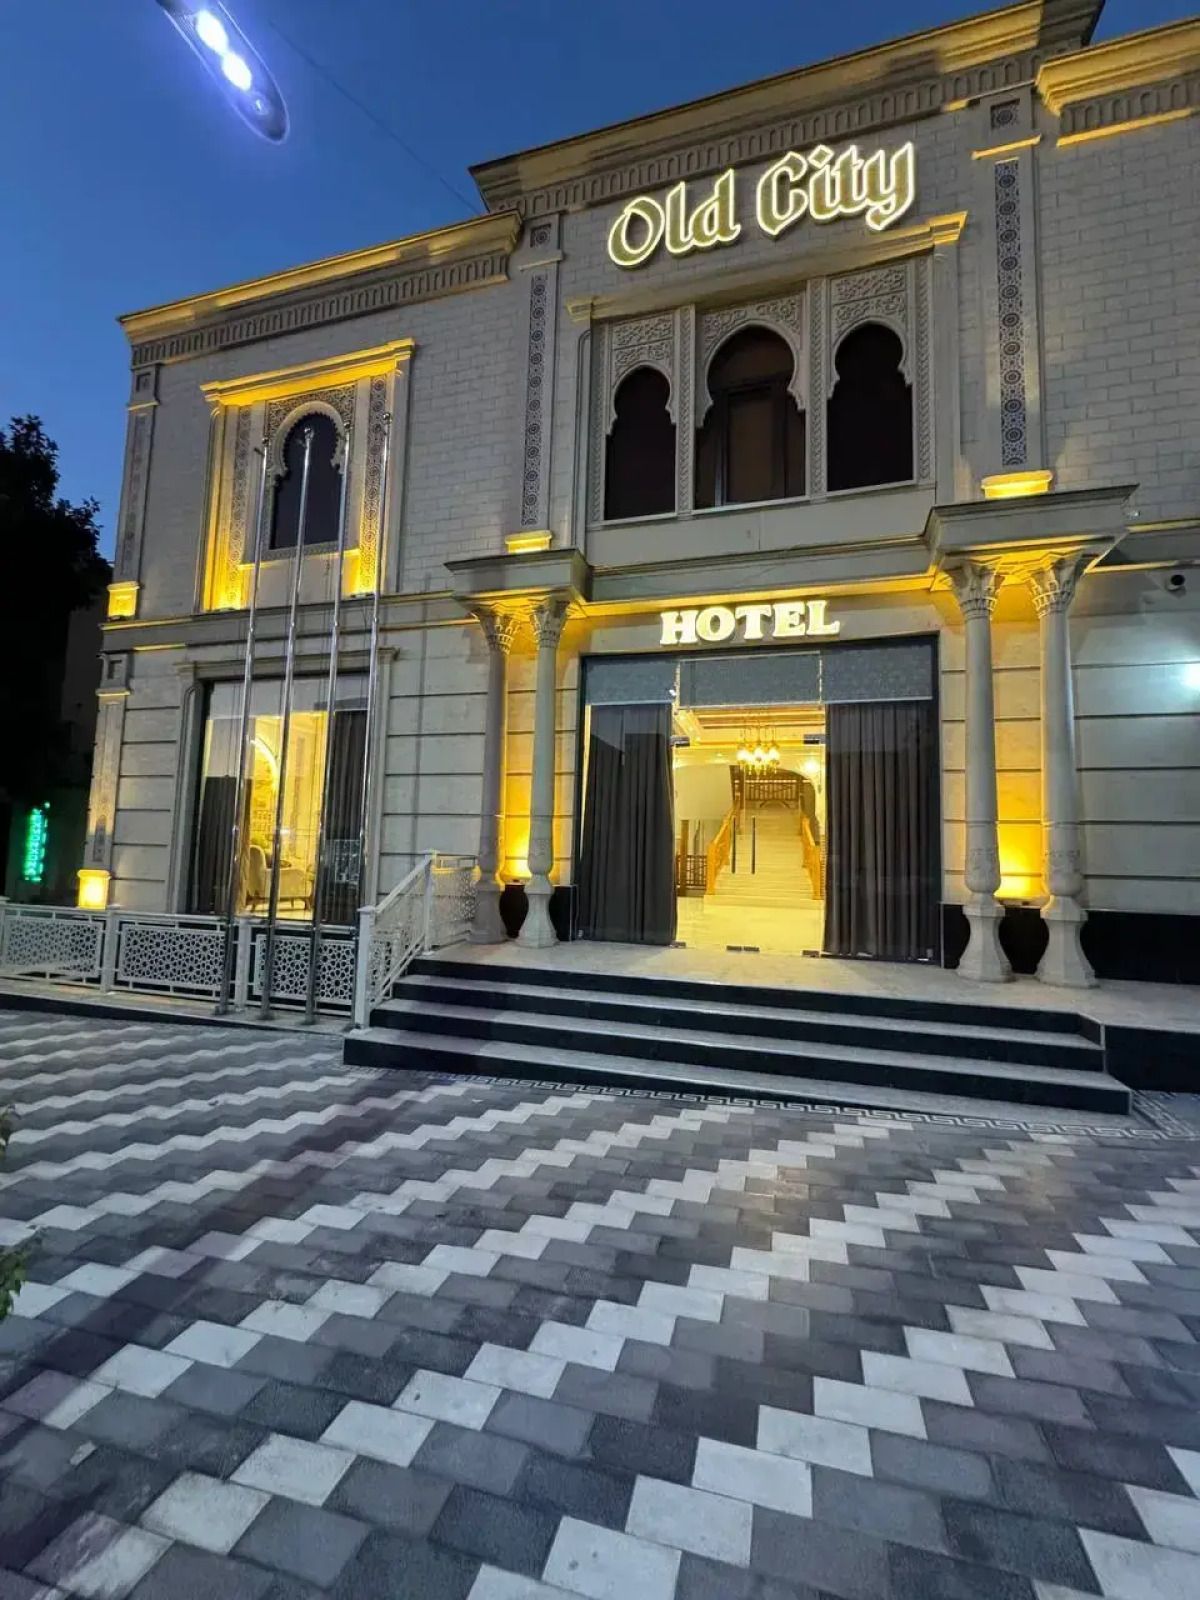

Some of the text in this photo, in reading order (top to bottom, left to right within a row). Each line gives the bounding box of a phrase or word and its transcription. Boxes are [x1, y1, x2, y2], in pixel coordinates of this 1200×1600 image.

[607, 141, 916, 267] Old City
[660, 599, 841, 646] HOTEL
